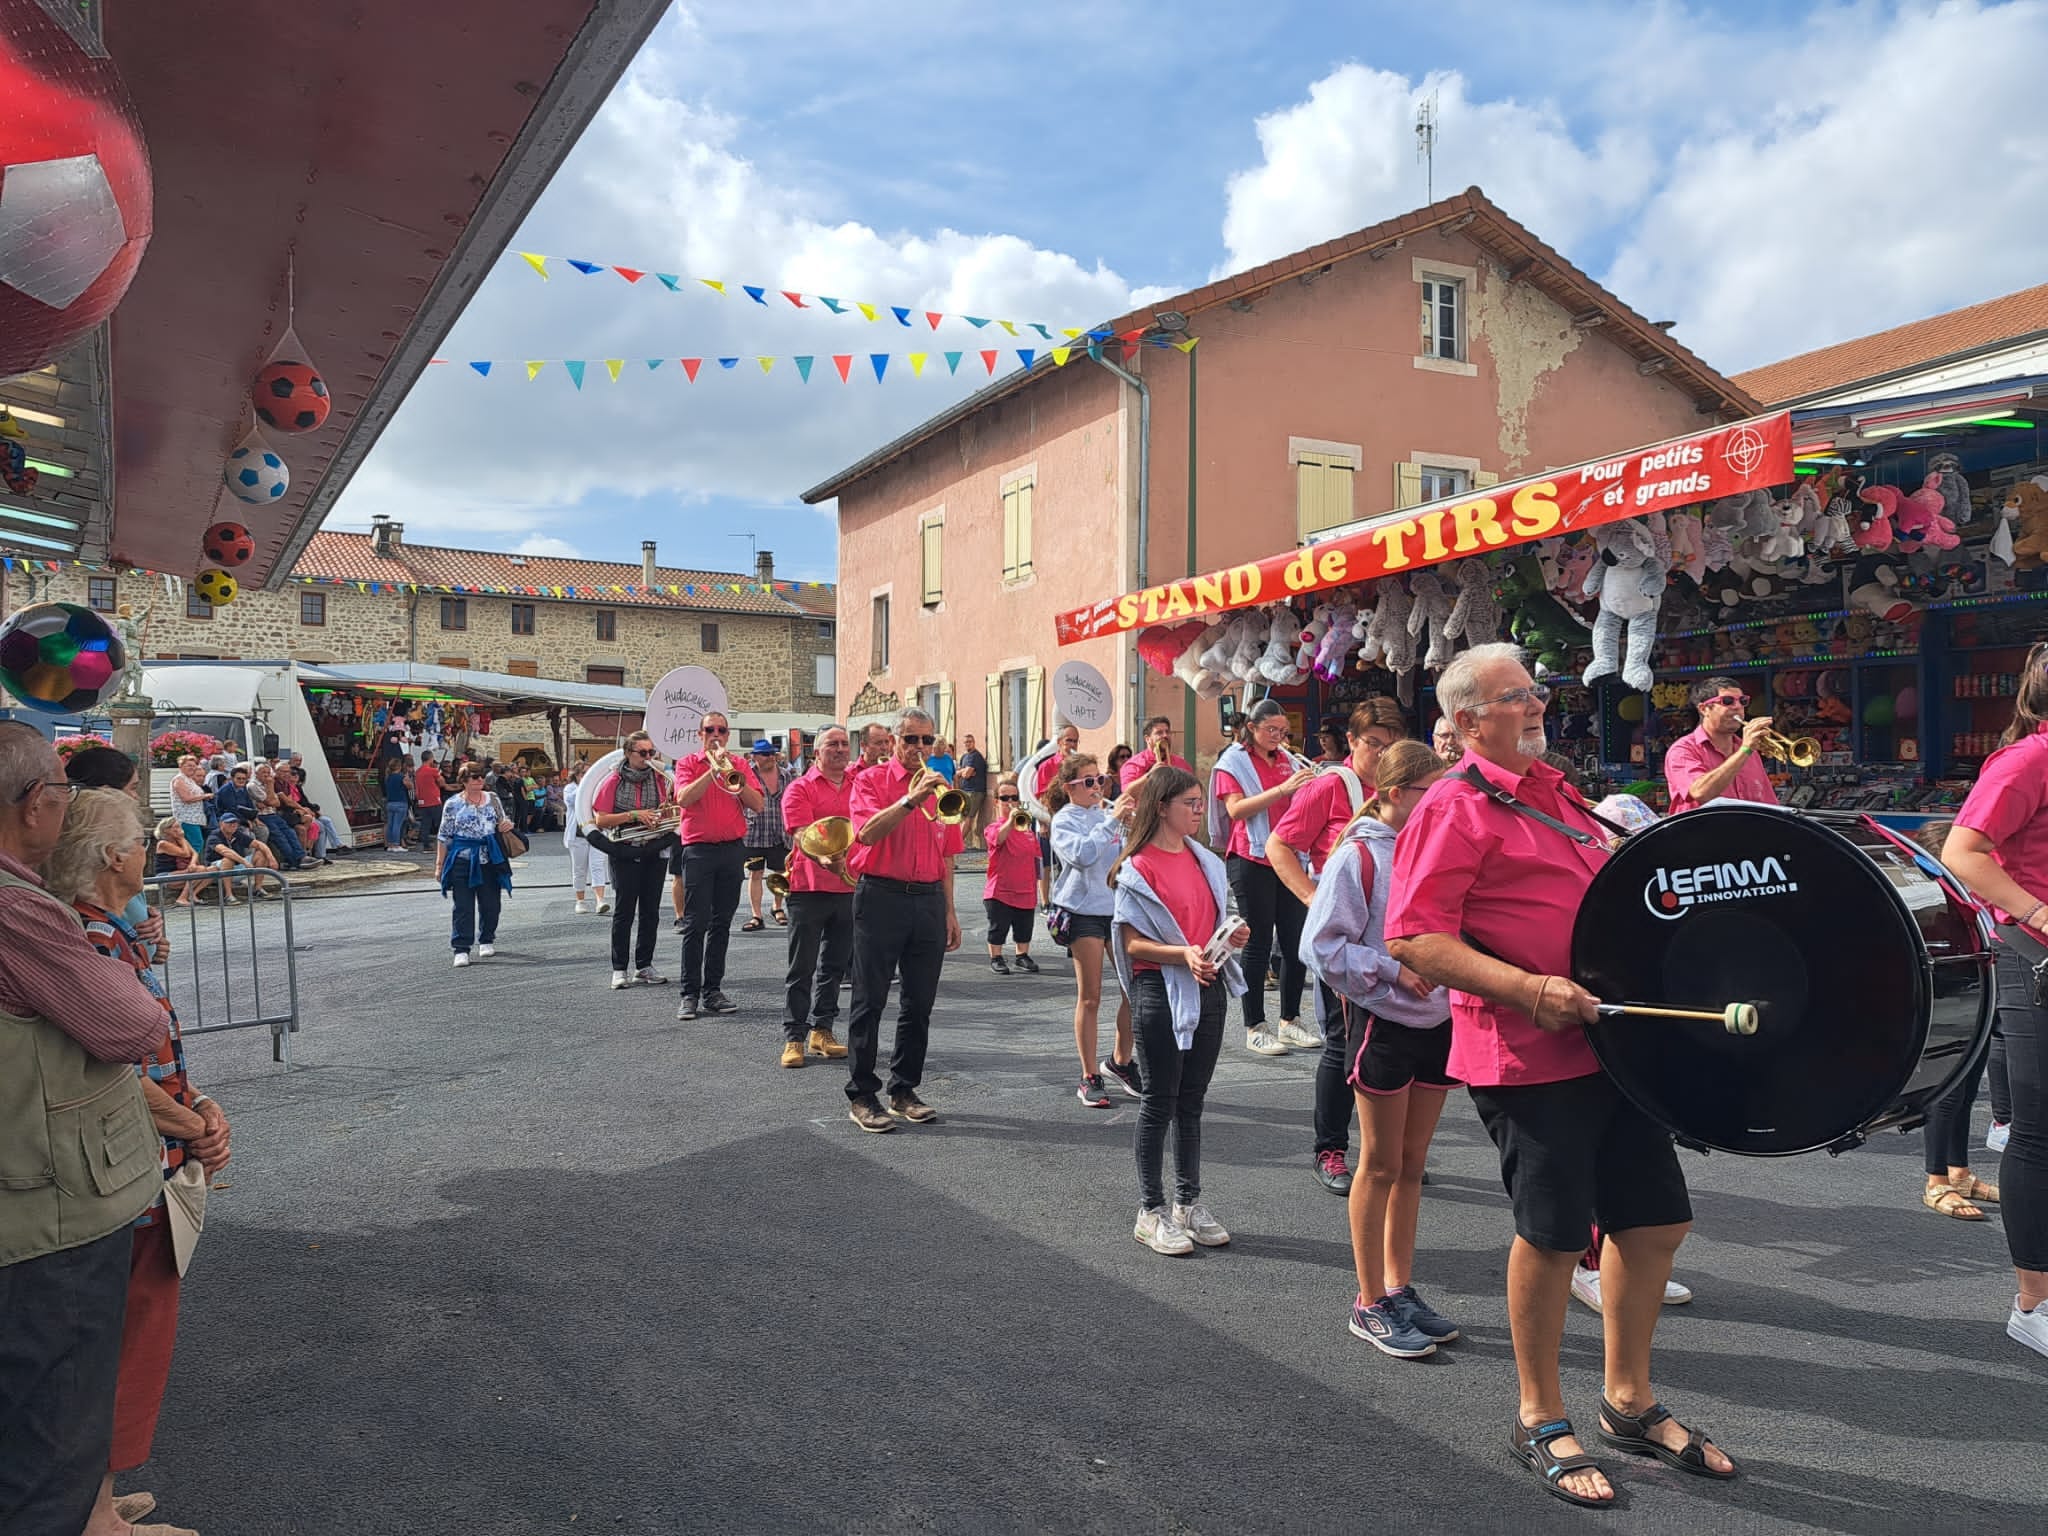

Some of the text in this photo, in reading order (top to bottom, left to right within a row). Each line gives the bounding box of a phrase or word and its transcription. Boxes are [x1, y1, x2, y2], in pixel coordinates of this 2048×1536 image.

[1580, 445, 1703, 484] Pour petits
[1603, 472, 1711, 506] et grands
[1117, 482, 1561, 629] STAND de TIRS
[1696, 883, 1787, 904] INNOVATION
